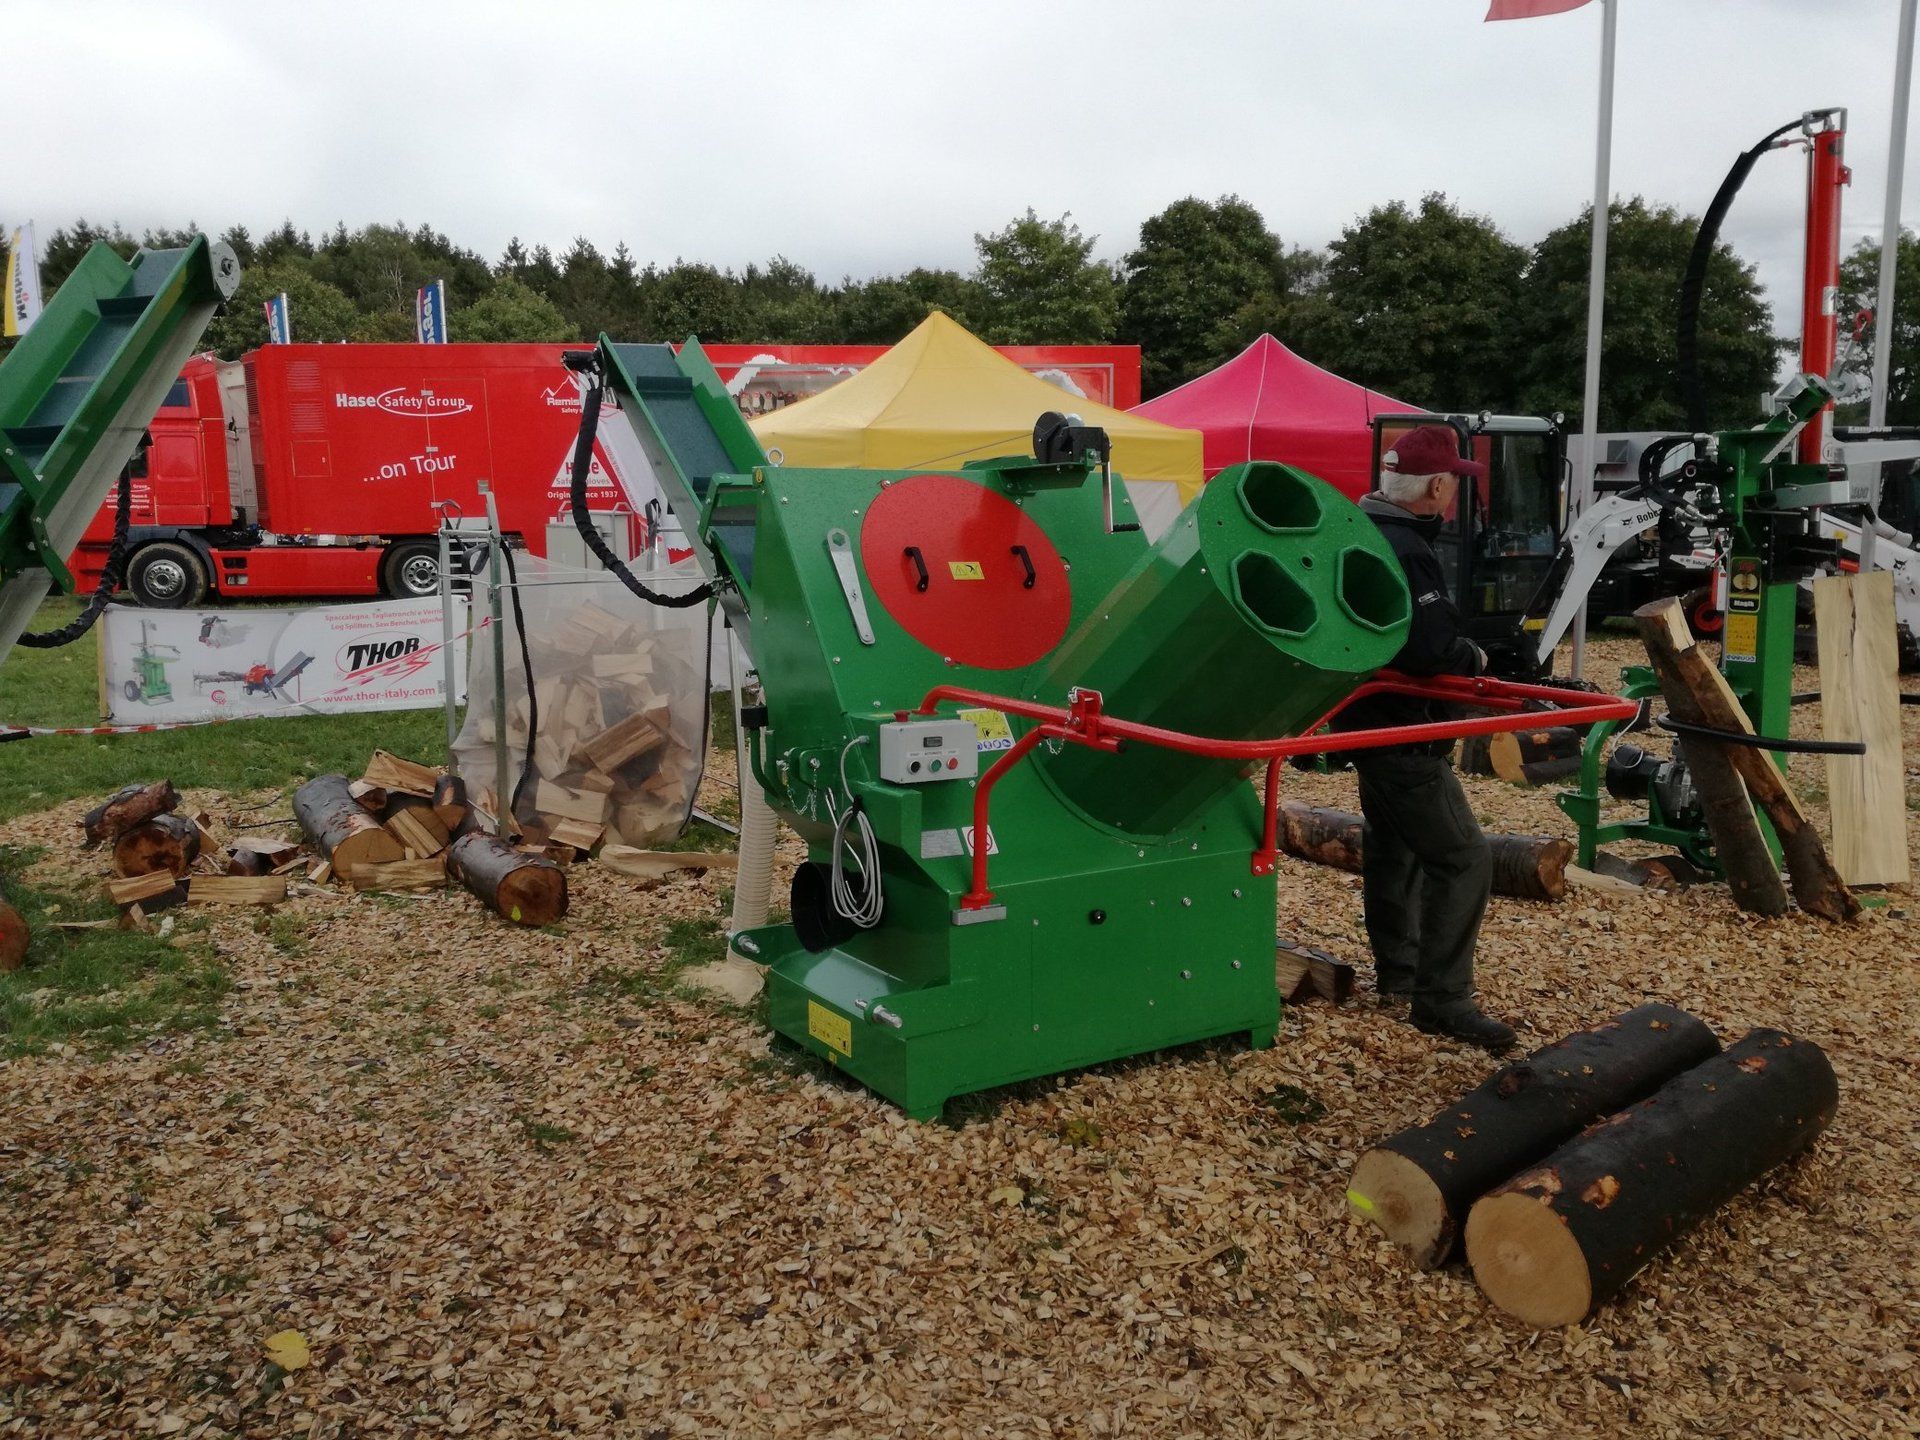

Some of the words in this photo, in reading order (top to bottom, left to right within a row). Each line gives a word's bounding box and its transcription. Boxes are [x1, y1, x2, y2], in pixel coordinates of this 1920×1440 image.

[336, 393, 376, 408] Hase
[384, 395, 423, 409] Safety
[427, 396, 465, 408] Group
[547, 398, 580, 406] Remis
[410, 455, 456, 474] Tour
[547, 491, 571, 499] Origin
[347, 637, 420, 671] THOR
[323, 687, 436, 703] www.thor-italy.com
